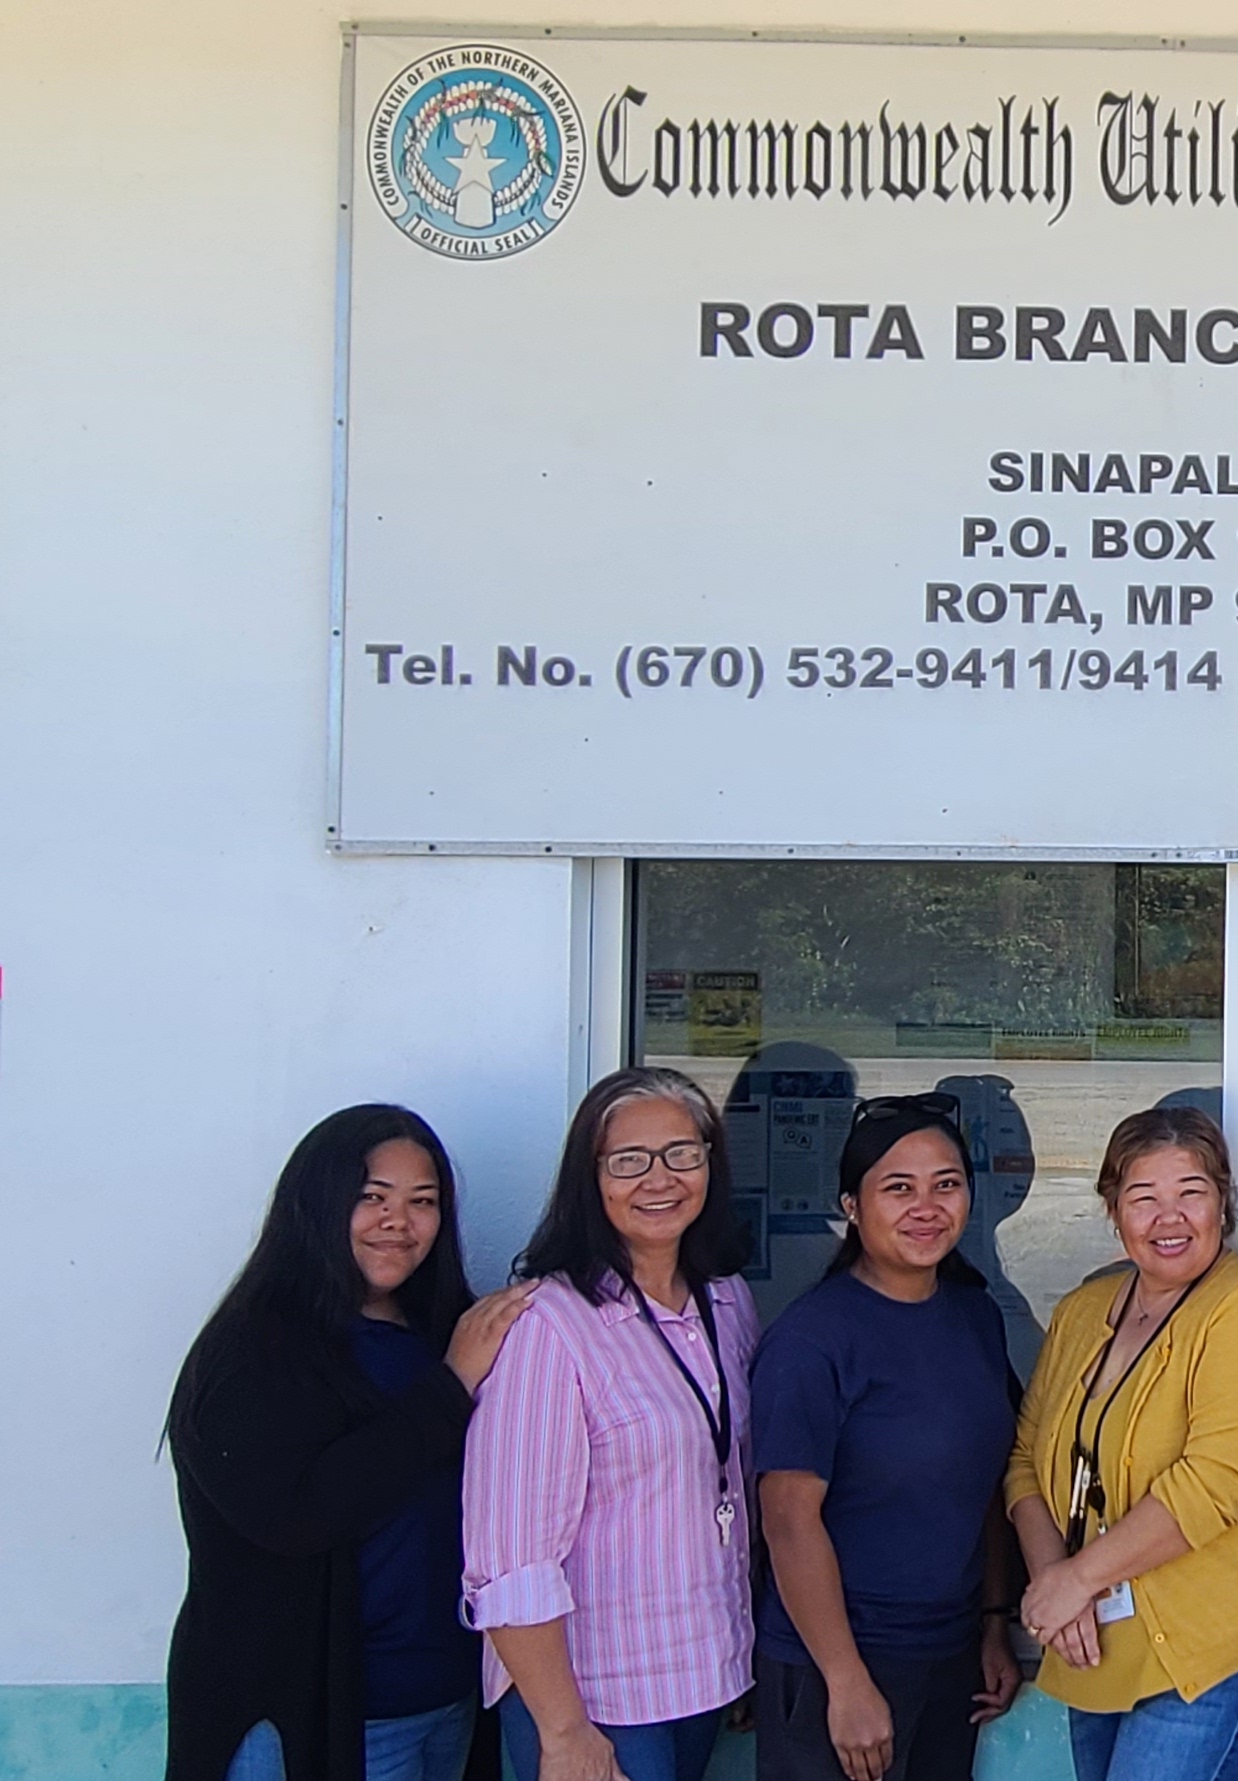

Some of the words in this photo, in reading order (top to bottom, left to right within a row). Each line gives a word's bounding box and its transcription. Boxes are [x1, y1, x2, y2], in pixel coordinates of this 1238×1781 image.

[407, 67, 425, 87] OF
[427, 53, 456, 74] THE
[461, 51, 540, 82] NORTHERN
[538, 79, 579, 144] MARIANA
[374, 84, 409, 206] COMMONWEALTH
[597, 85, 1073, 226] Commonwealth
[551, 149, 580, 210] ISLANDS
[420, 228, 488, 255] OFFICIAL
[495, 228, 532, 252] SEAL
[701, 303, 924, 361] ROTA
[963, 518, 1067, 559] P.O.
[1092, 519, 1215, 561] BOX
[926, 583, 1103, 635] ROTA,
[1128, 586, 1214, 626] MP
[366, 645, 471, 686] Tel.
[498, 647, 591, 687] No.
[616, 646, 764, 699] (670)
[789, 648, 1222, 692] 532-9411/9414
[696, 975, 756, 988] CAUTION
